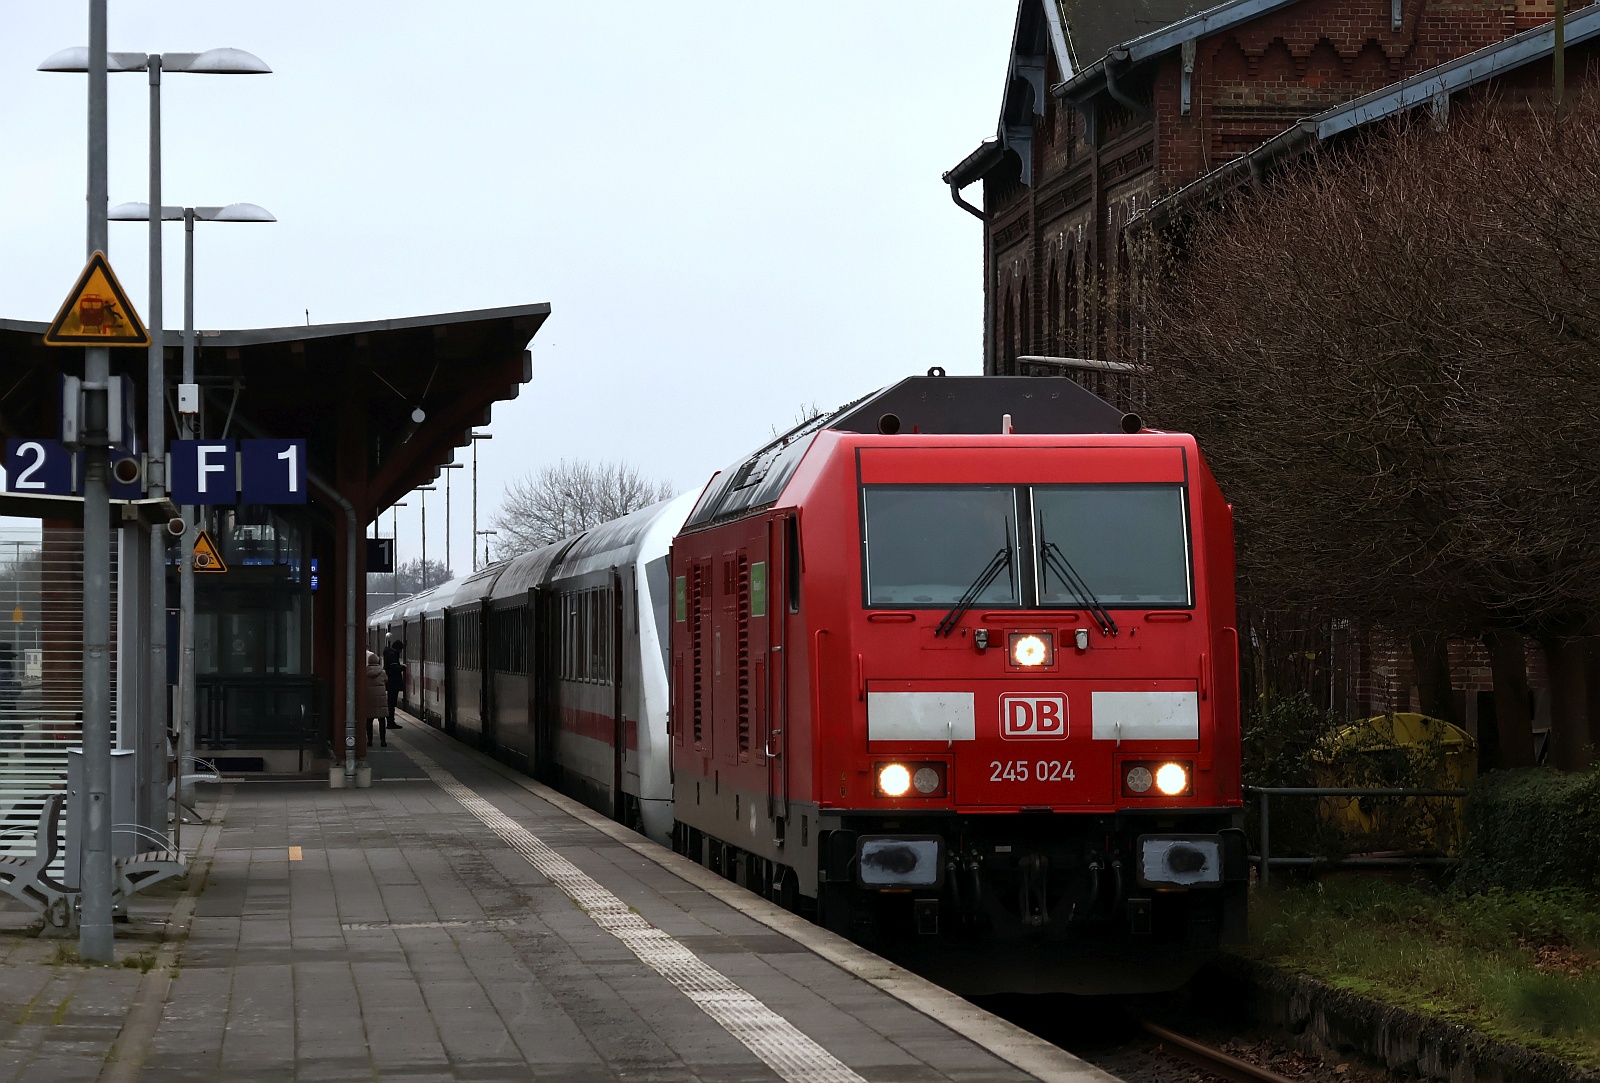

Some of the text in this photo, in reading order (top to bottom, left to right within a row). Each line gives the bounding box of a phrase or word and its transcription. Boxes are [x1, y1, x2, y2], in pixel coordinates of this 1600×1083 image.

[15, 441, 46, 489] 2
[197, 445, 227, 493] F
[277, 444, 298, 492] 1
[378, 540, 389, 565] 1
[1007, 699, 1062, 733] DB
[989, 760, 1076, 782] 245 024
